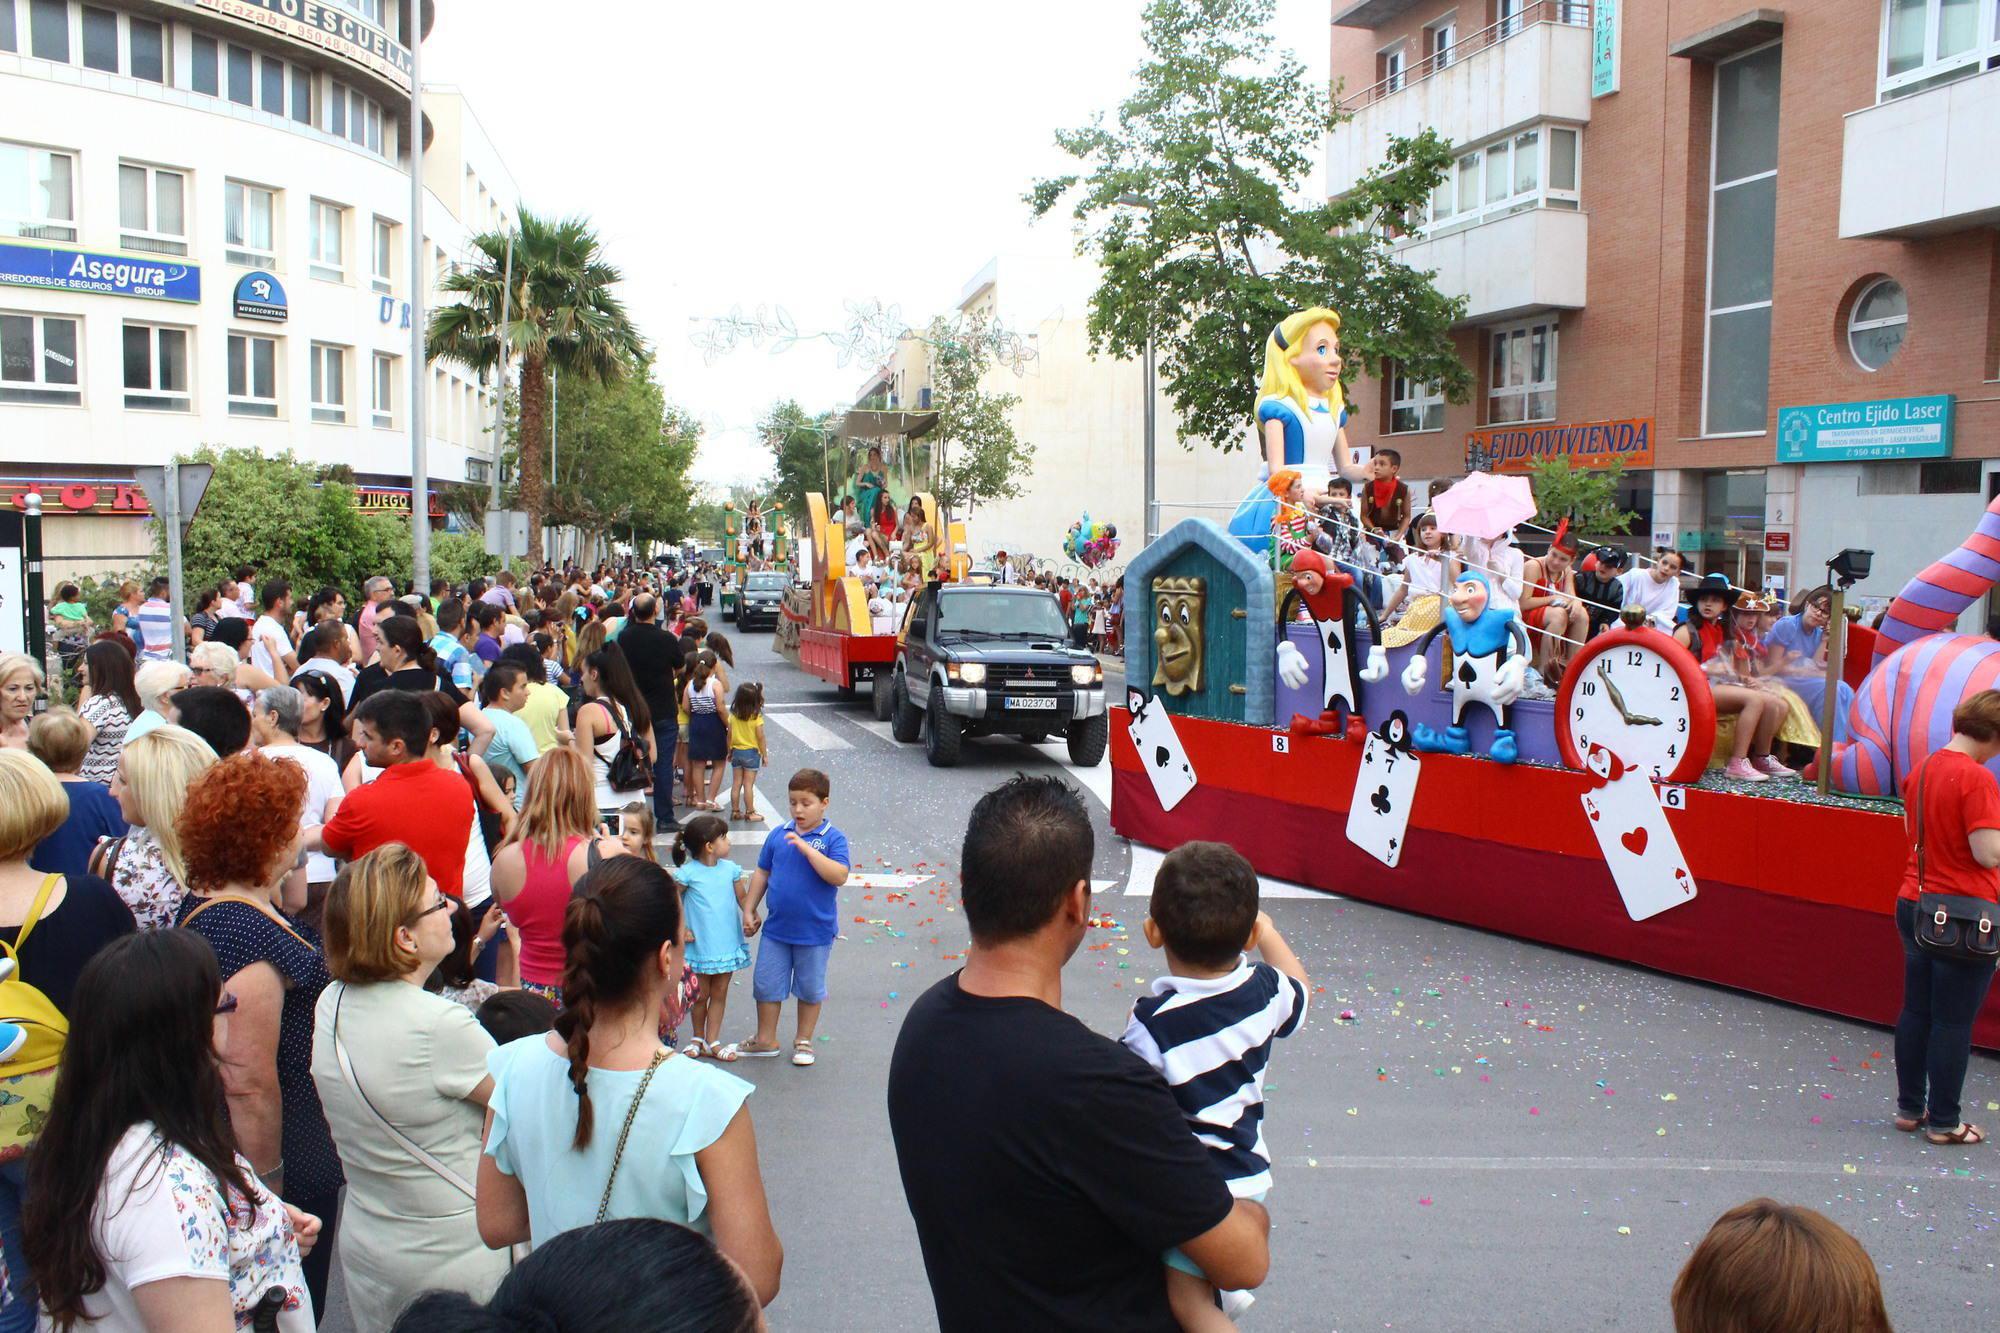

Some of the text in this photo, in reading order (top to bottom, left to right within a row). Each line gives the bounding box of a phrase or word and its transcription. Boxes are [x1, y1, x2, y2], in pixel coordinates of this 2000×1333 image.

[69, 255, 166, 287] Asegura
[54, 279, 67, 288] DE
[69, 280, 112, 291] SEGUROS
[134, 286, 166, 297] GROUP
[1817, 409, 1861, 425] Centro
[1866, 404, 1899, 427] Ejido
[1904, 403, 1943, 420] Laser
[1490, 422, 1648, 464] EJIDOVIVIENDA
[1854, 446, 1905, 457] 950 48 22 14
[366, 493, 407, 506] JUEGO
[1776, 509, 1783, 522] 2
[1626, 651, 1643, 667] 12
[1601, 659, 1612, 674] 11
[1655, 664, 1661, 678] 1
[1581, 682, 1596, 696] 10
[1670, 686, 1680, 701] 2
[1022, 699, 1043, 708] 0237
[1045, 699, 1056, 708] CK
[1576, 708, 1584, 721] 9
[1677, 718, 1686, 733] 3
[1276, 737, 1284, 751] 8
[1368, 740, 1375, 752] A
[1580, 734, 1588, 749] 8
[1667, 744, 1676, 758] 4
[1385, 759, 1395, 773] 7
[1653, 766, 1661, 777] 5
[1586, 797, 1596, 812] A
[1666, 789, 1680, 806] 6
[1680, 880, 1690, 895] A
